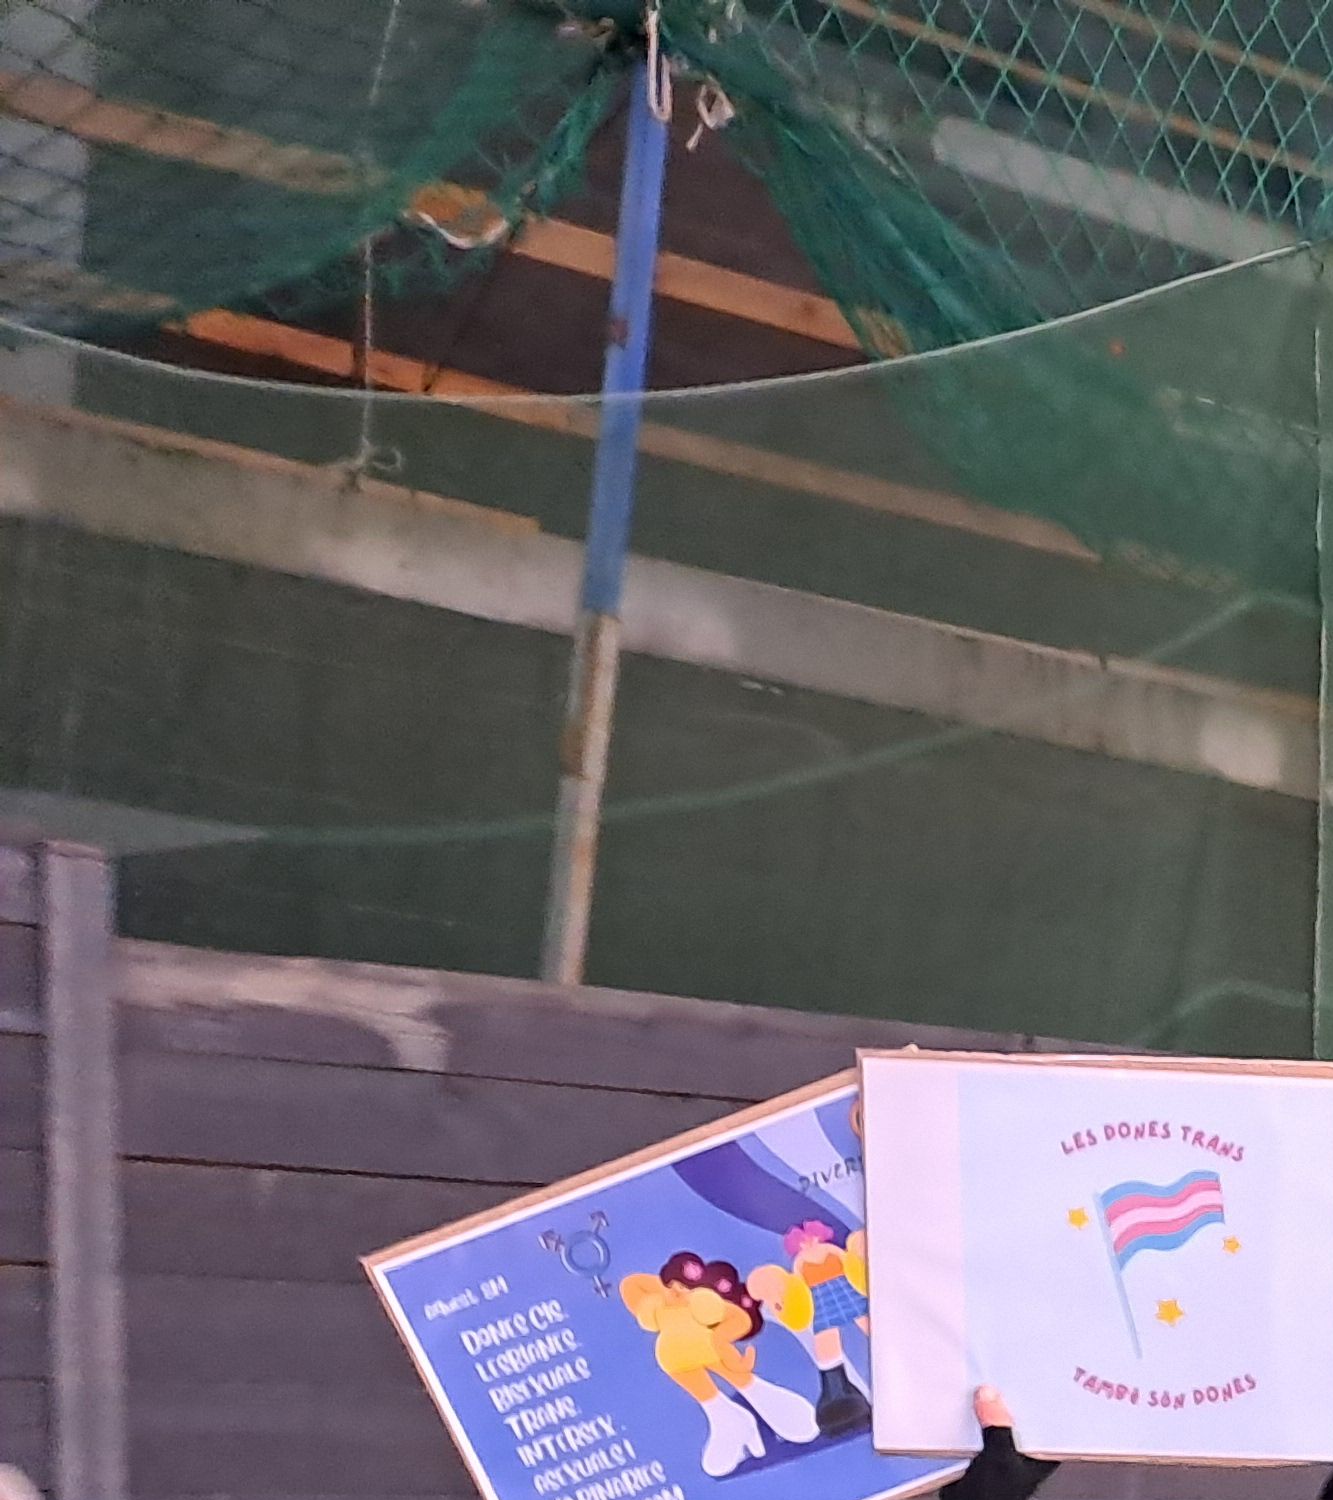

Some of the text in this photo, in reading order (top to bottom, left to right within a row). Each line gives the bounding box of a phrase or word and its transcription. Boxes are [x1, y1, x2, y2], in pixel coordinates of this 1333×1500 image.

[1060, 1120, 1245, 1162] LES DONES TRANS
[459, 1312, 531, 1357] DONES
[1192, 1373, 1257, 1406] DONES
